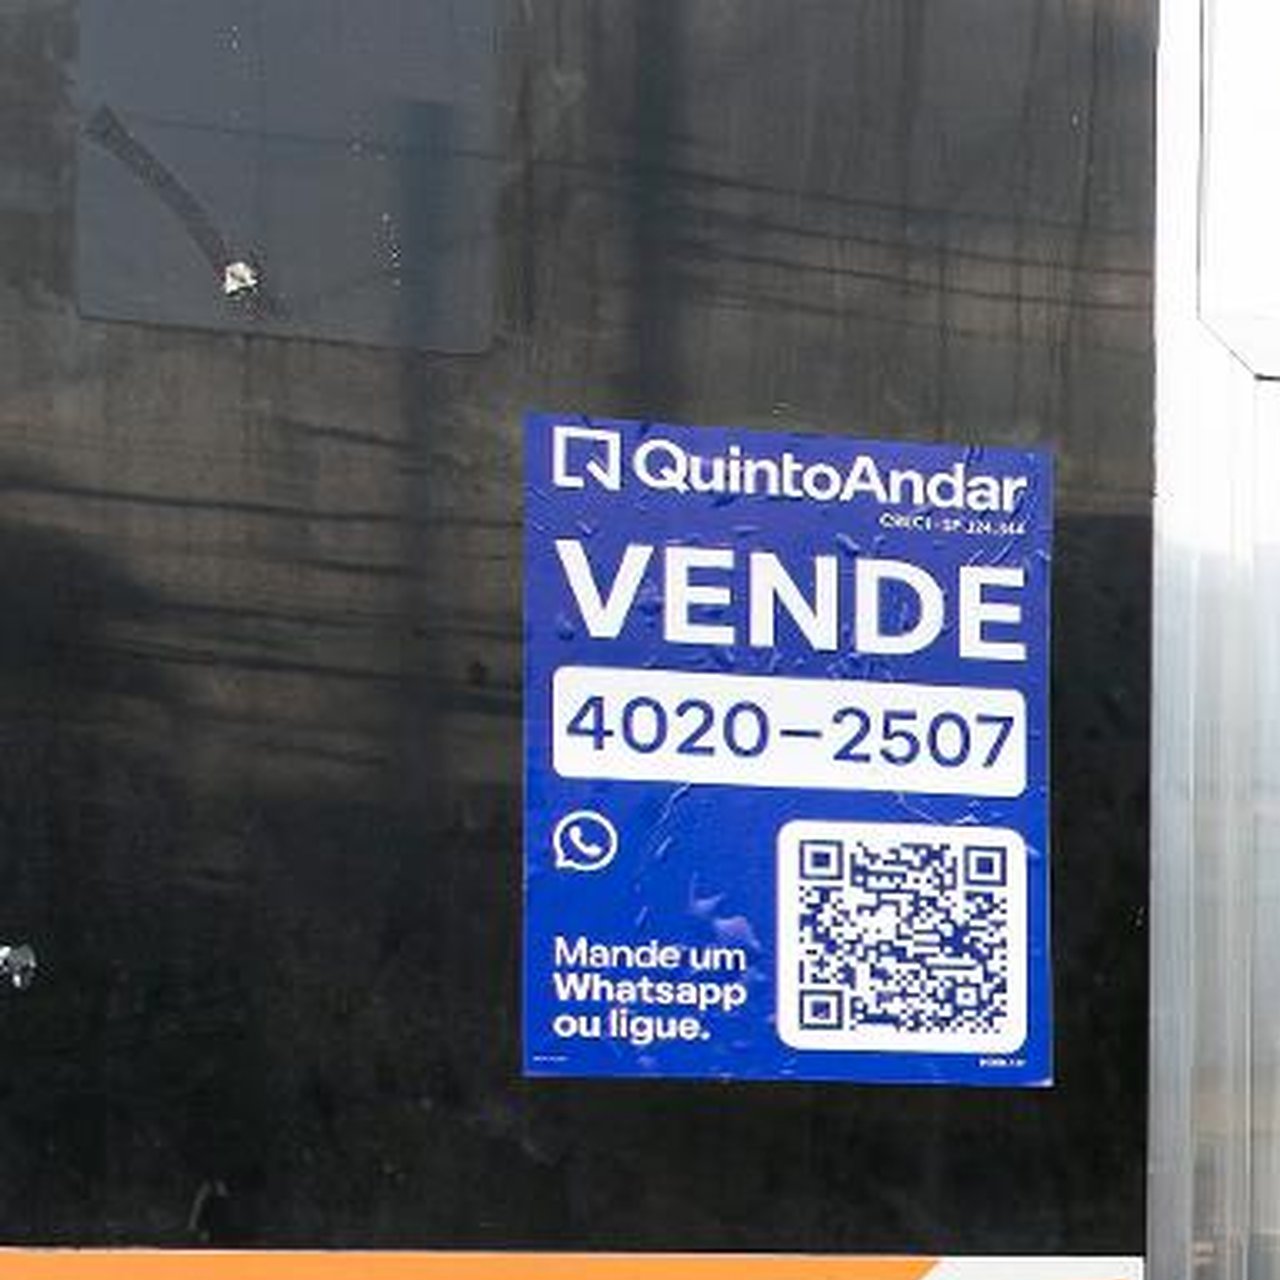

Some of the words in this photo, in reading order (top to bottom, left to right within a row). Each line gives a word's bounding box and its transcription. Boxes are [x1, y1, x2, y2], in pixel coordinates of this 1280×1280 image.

[633, 439, 1027, 512] QuintoAndar
[555, 539, 1026, 661] VENDE
[566, 695, 1015, 768] 4020-2507
[555, 936, 681, 969] Mande
[689, 947, 747, 971] um
[553, 972, 747, 1012] Whatsapp
[553, 1014, 601, 1038] ou
[608, 1007, 711, 1046] ligue.
